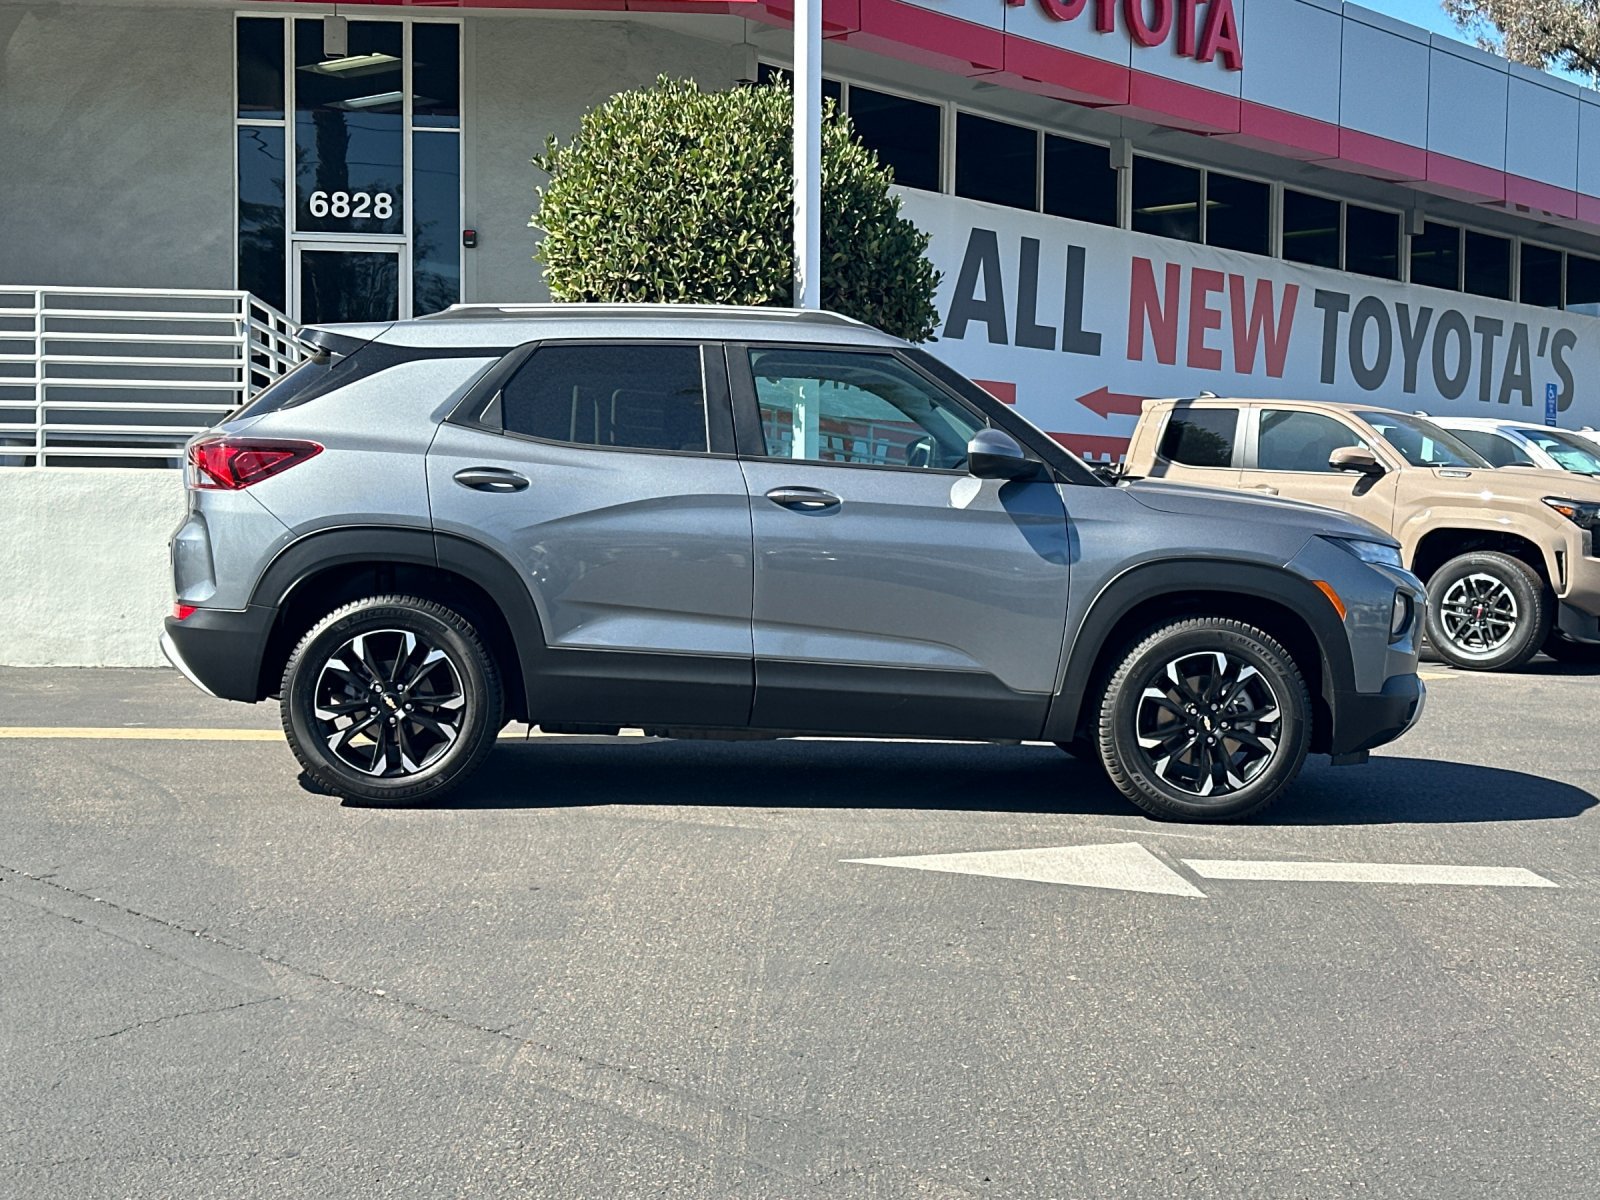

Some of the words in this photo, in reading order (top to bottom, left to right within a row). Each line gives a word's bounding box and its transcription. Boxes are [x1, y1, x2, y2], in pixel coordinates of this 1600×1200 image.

[309, 190, 393, 219] 6828
[942, 226, 1102, 356] ALL
[1126, 256, 1299, 379] NEW
[1314, 288, 1578, 412] TOYOTA'S
[1237, 637, 1285, 674] MICHELIN
